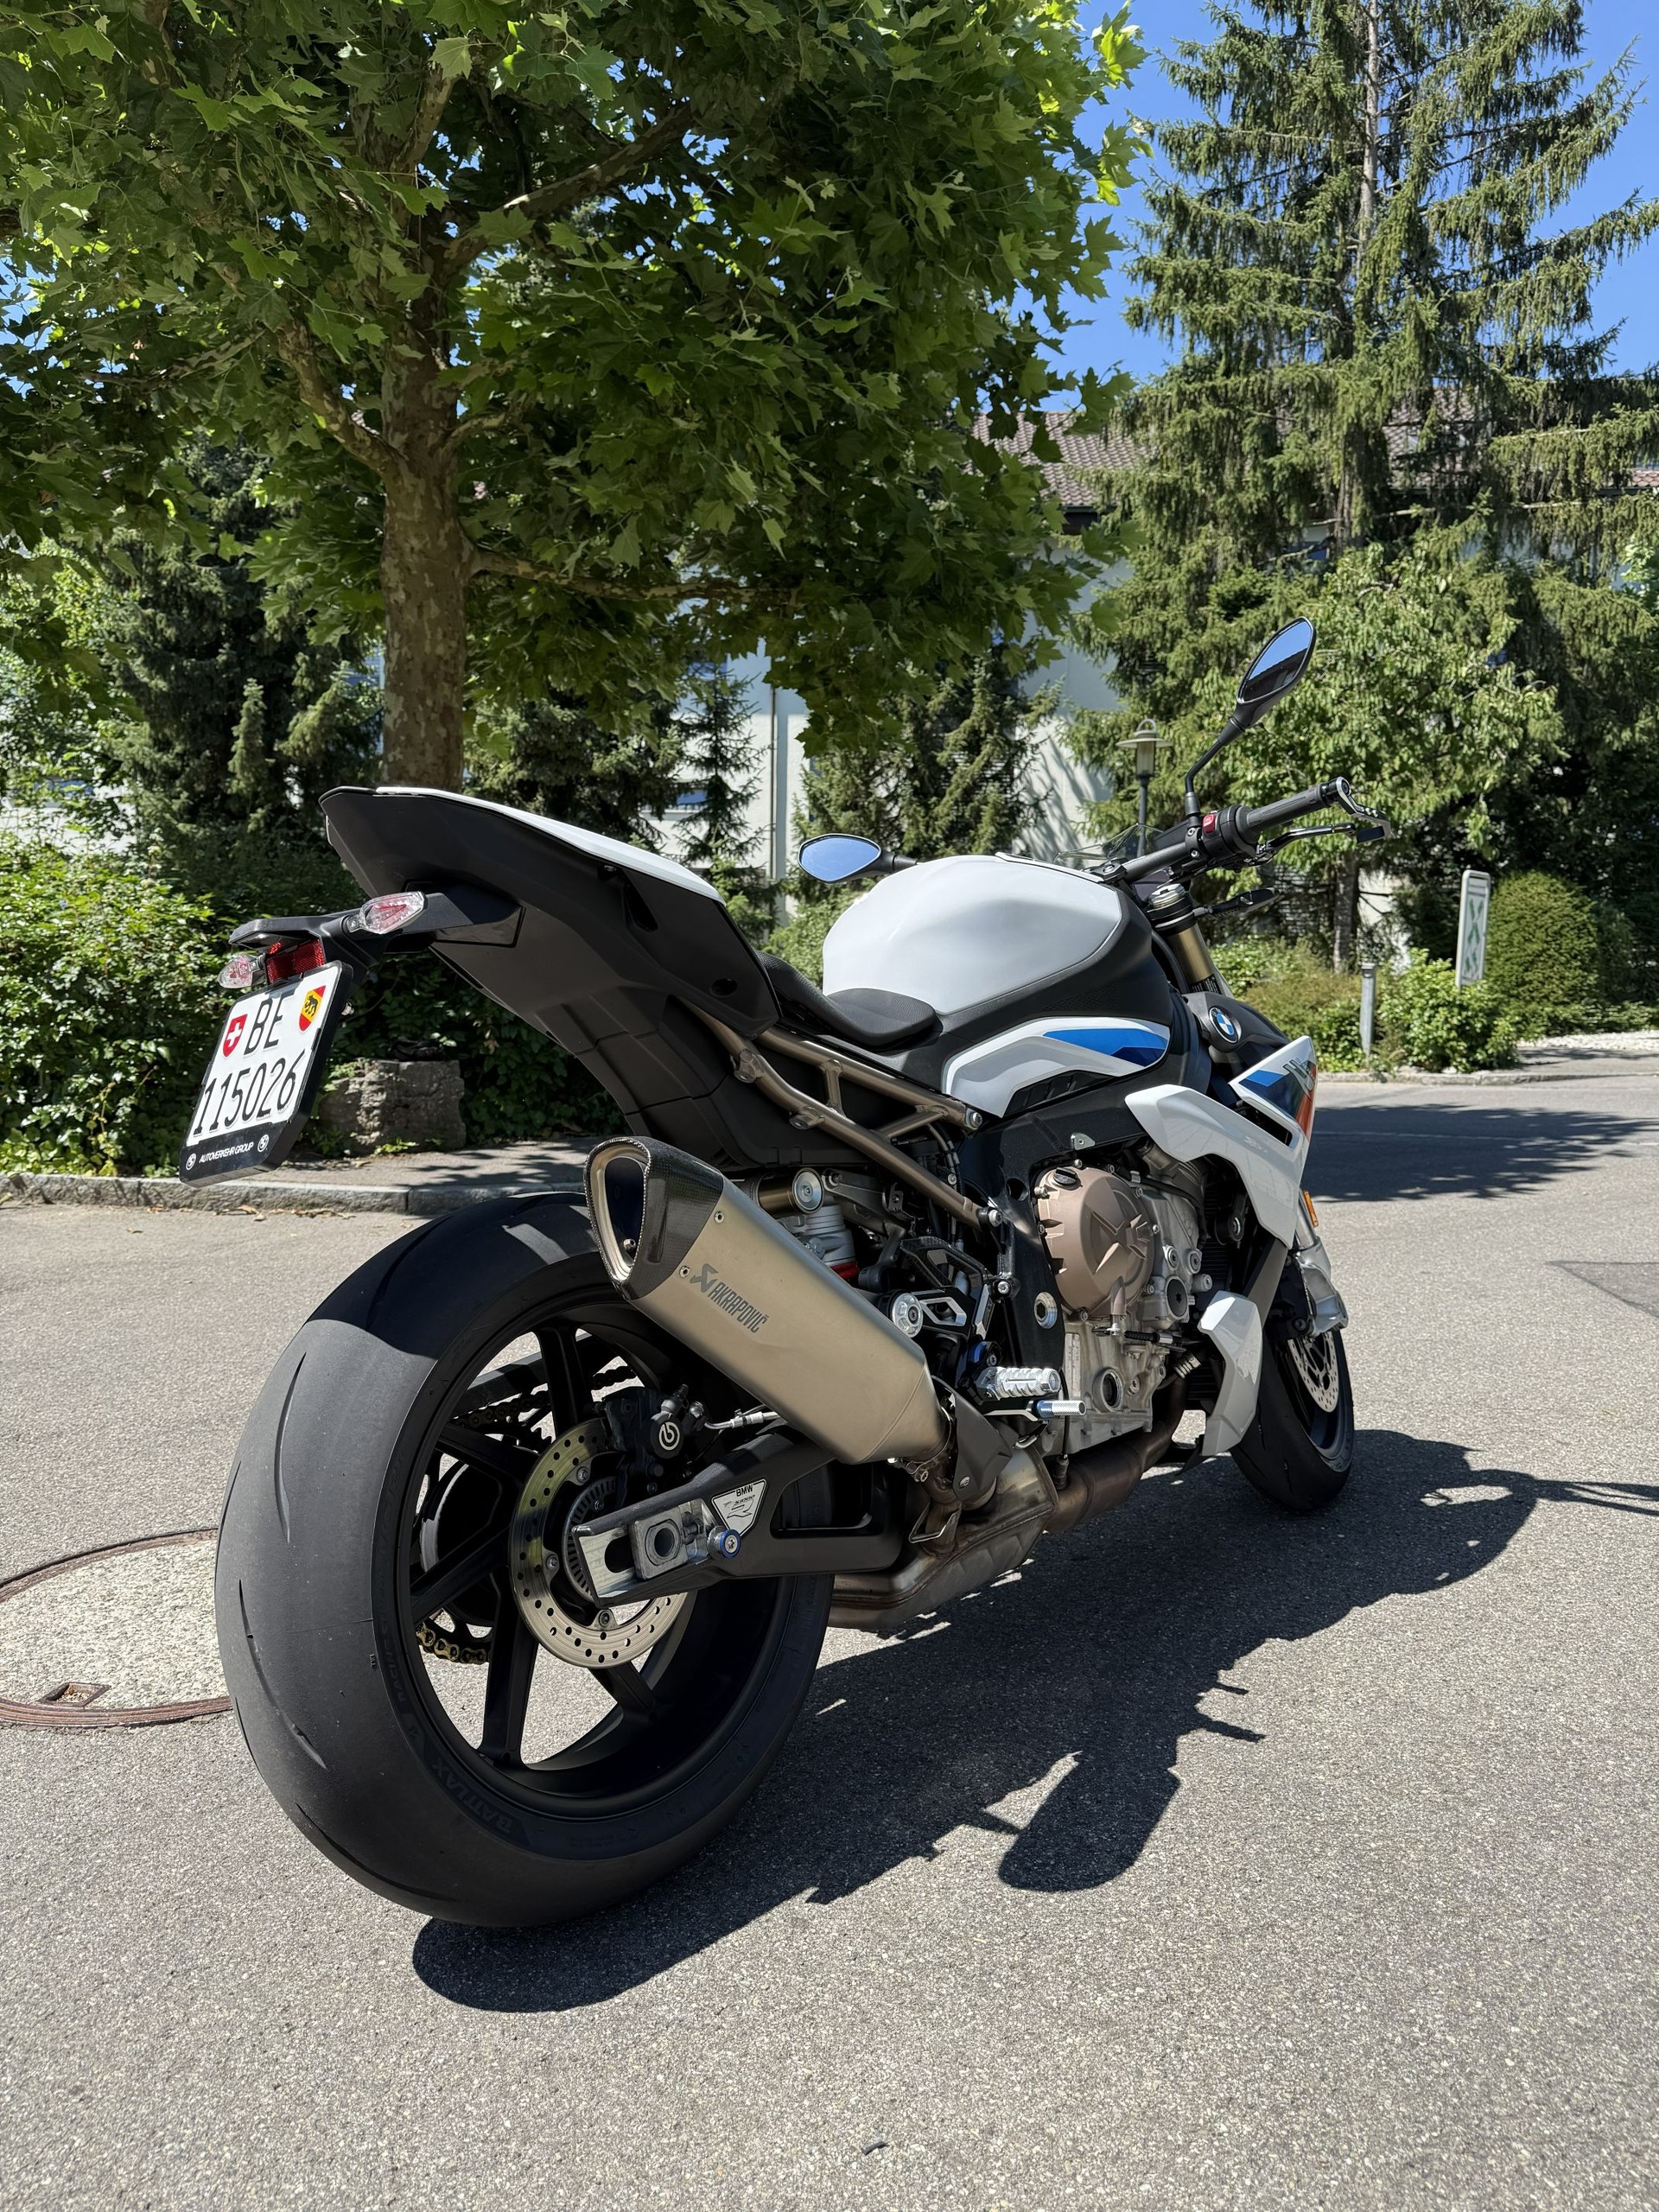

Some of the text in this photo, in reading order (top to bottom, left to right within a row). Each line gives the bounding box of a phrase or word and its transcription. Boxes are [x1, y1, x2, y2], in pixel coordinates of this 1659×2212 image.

[243, 993, 283, 1056] BE
[193, 1048, 306, 1135] 115026
[199, 1141, 254, 1164] AUTOVERKEHR GROUP
[735, 1484, 753, 1497] BMW
[431, 1755, 513, 1834] BATTLAX
